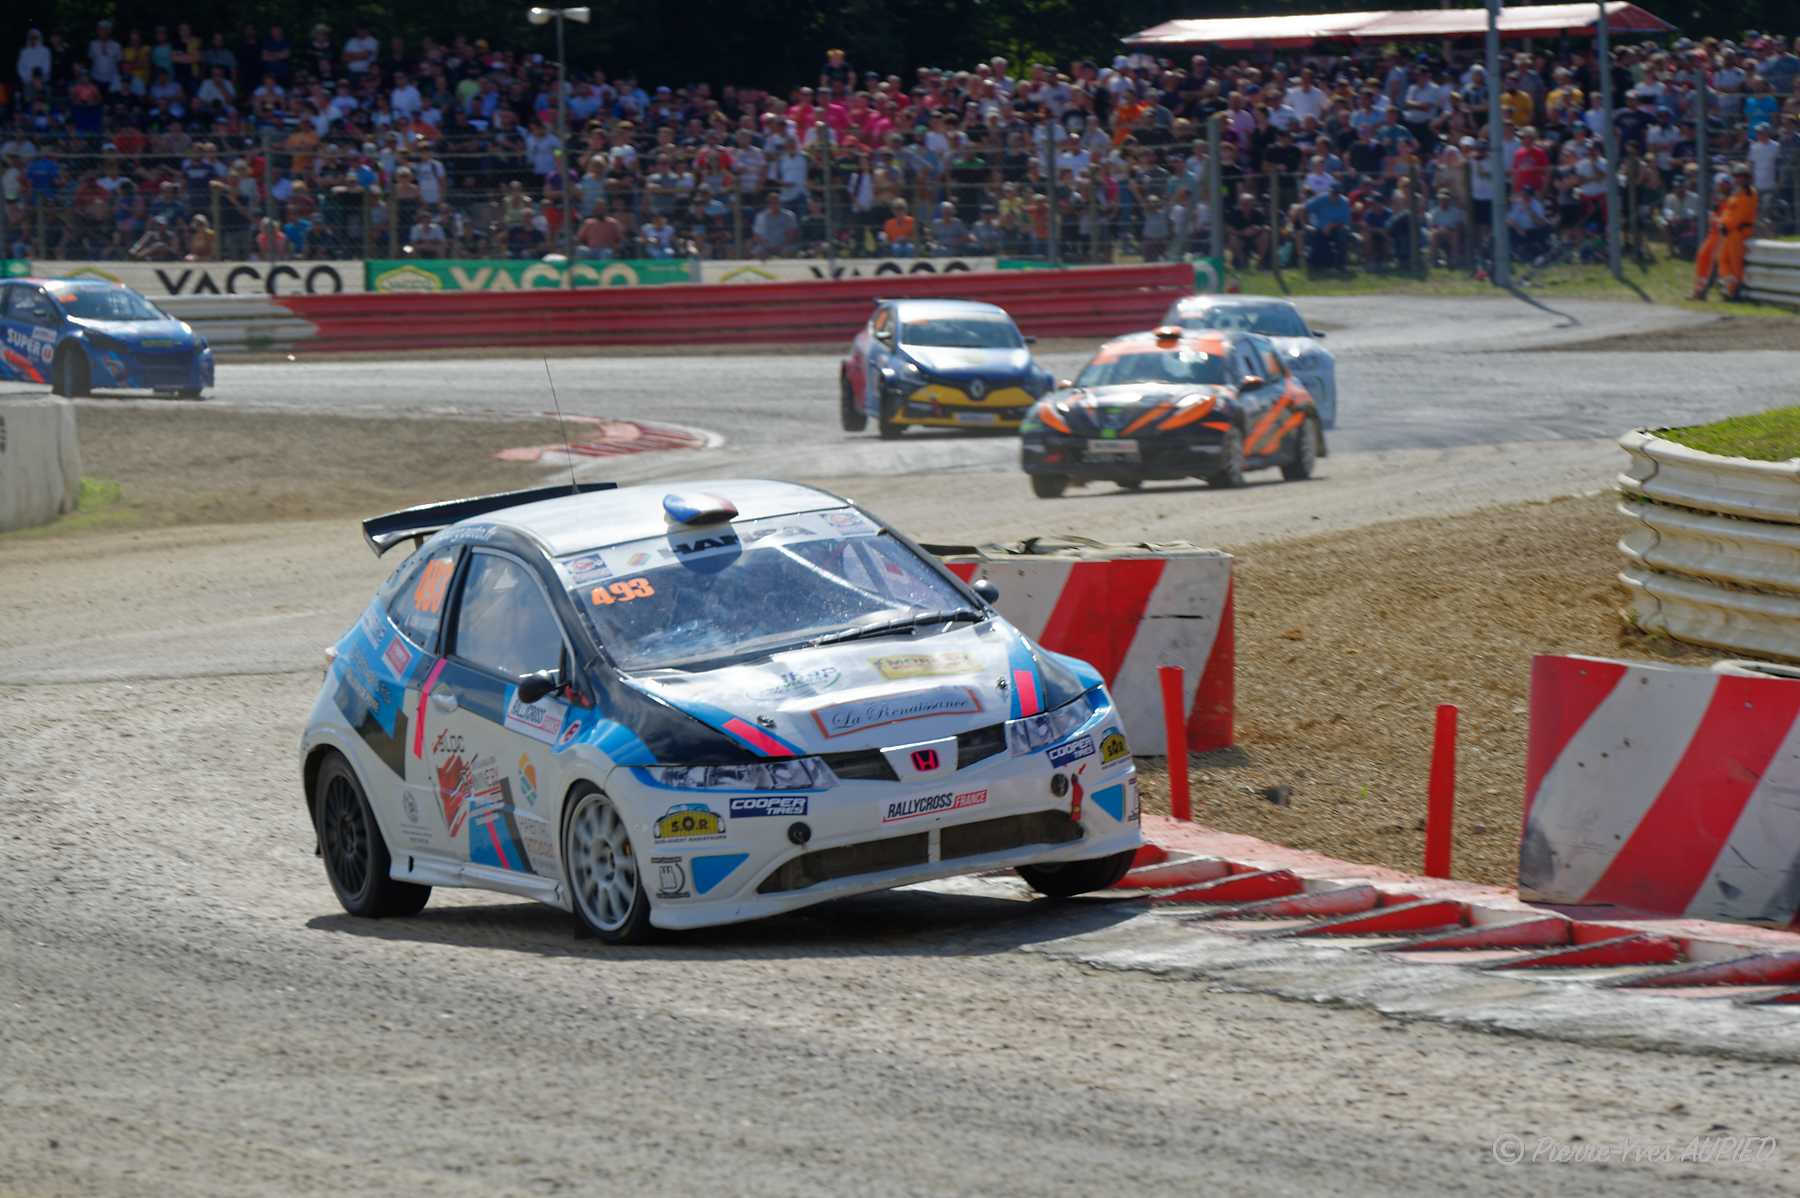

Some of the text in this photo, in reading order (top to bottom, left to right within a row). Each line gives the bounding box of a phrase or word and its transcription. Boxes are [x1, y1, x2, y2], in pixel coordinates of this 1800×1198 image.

[7, 328, 41, 356] SUPER
[592, 577, 655, 606] 493
[1048, 737, 1092, 758] COOPER
[731, 798, 806, 810] COOPER
[767, 807, 803, 815] TIRES
[887, 793, 953, 818] RALLYCROSS
